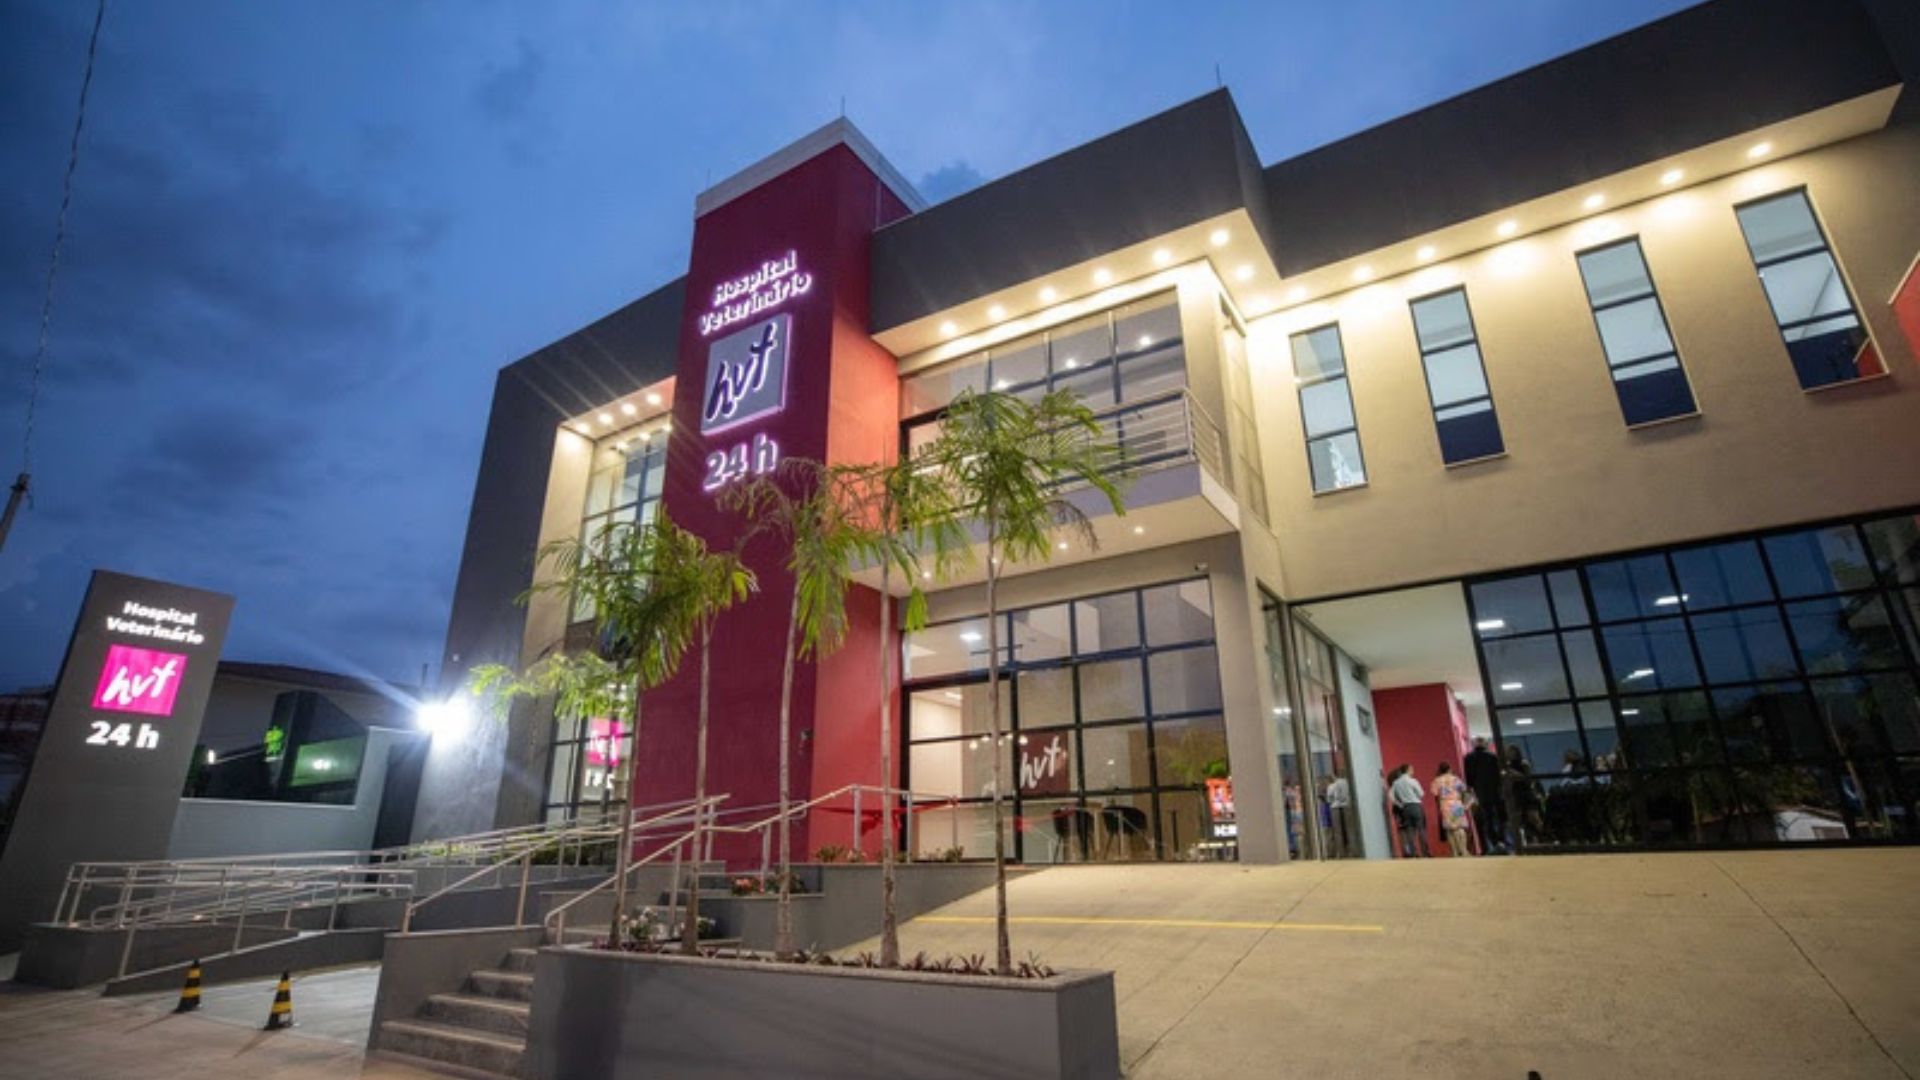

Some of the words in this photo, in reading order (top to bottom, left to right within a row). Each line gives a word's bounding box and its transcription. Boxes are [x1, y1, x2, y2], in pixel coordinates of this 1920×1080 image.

[714, 250, 796, 306] Hospital
[704, 321, 777, 422] hvt
[703, 442, 748, 492] 24
[753, 431, 778, 475] h
[106, 616, 205, 645] Veterinário
[123, 601, 197, 625] Hospital
[102, 659, 177, 705] hvt
[85, 719, 133, 746] 24
[135, 722, 160, 749] h
[1019, 735, 1062, 789] hvt
